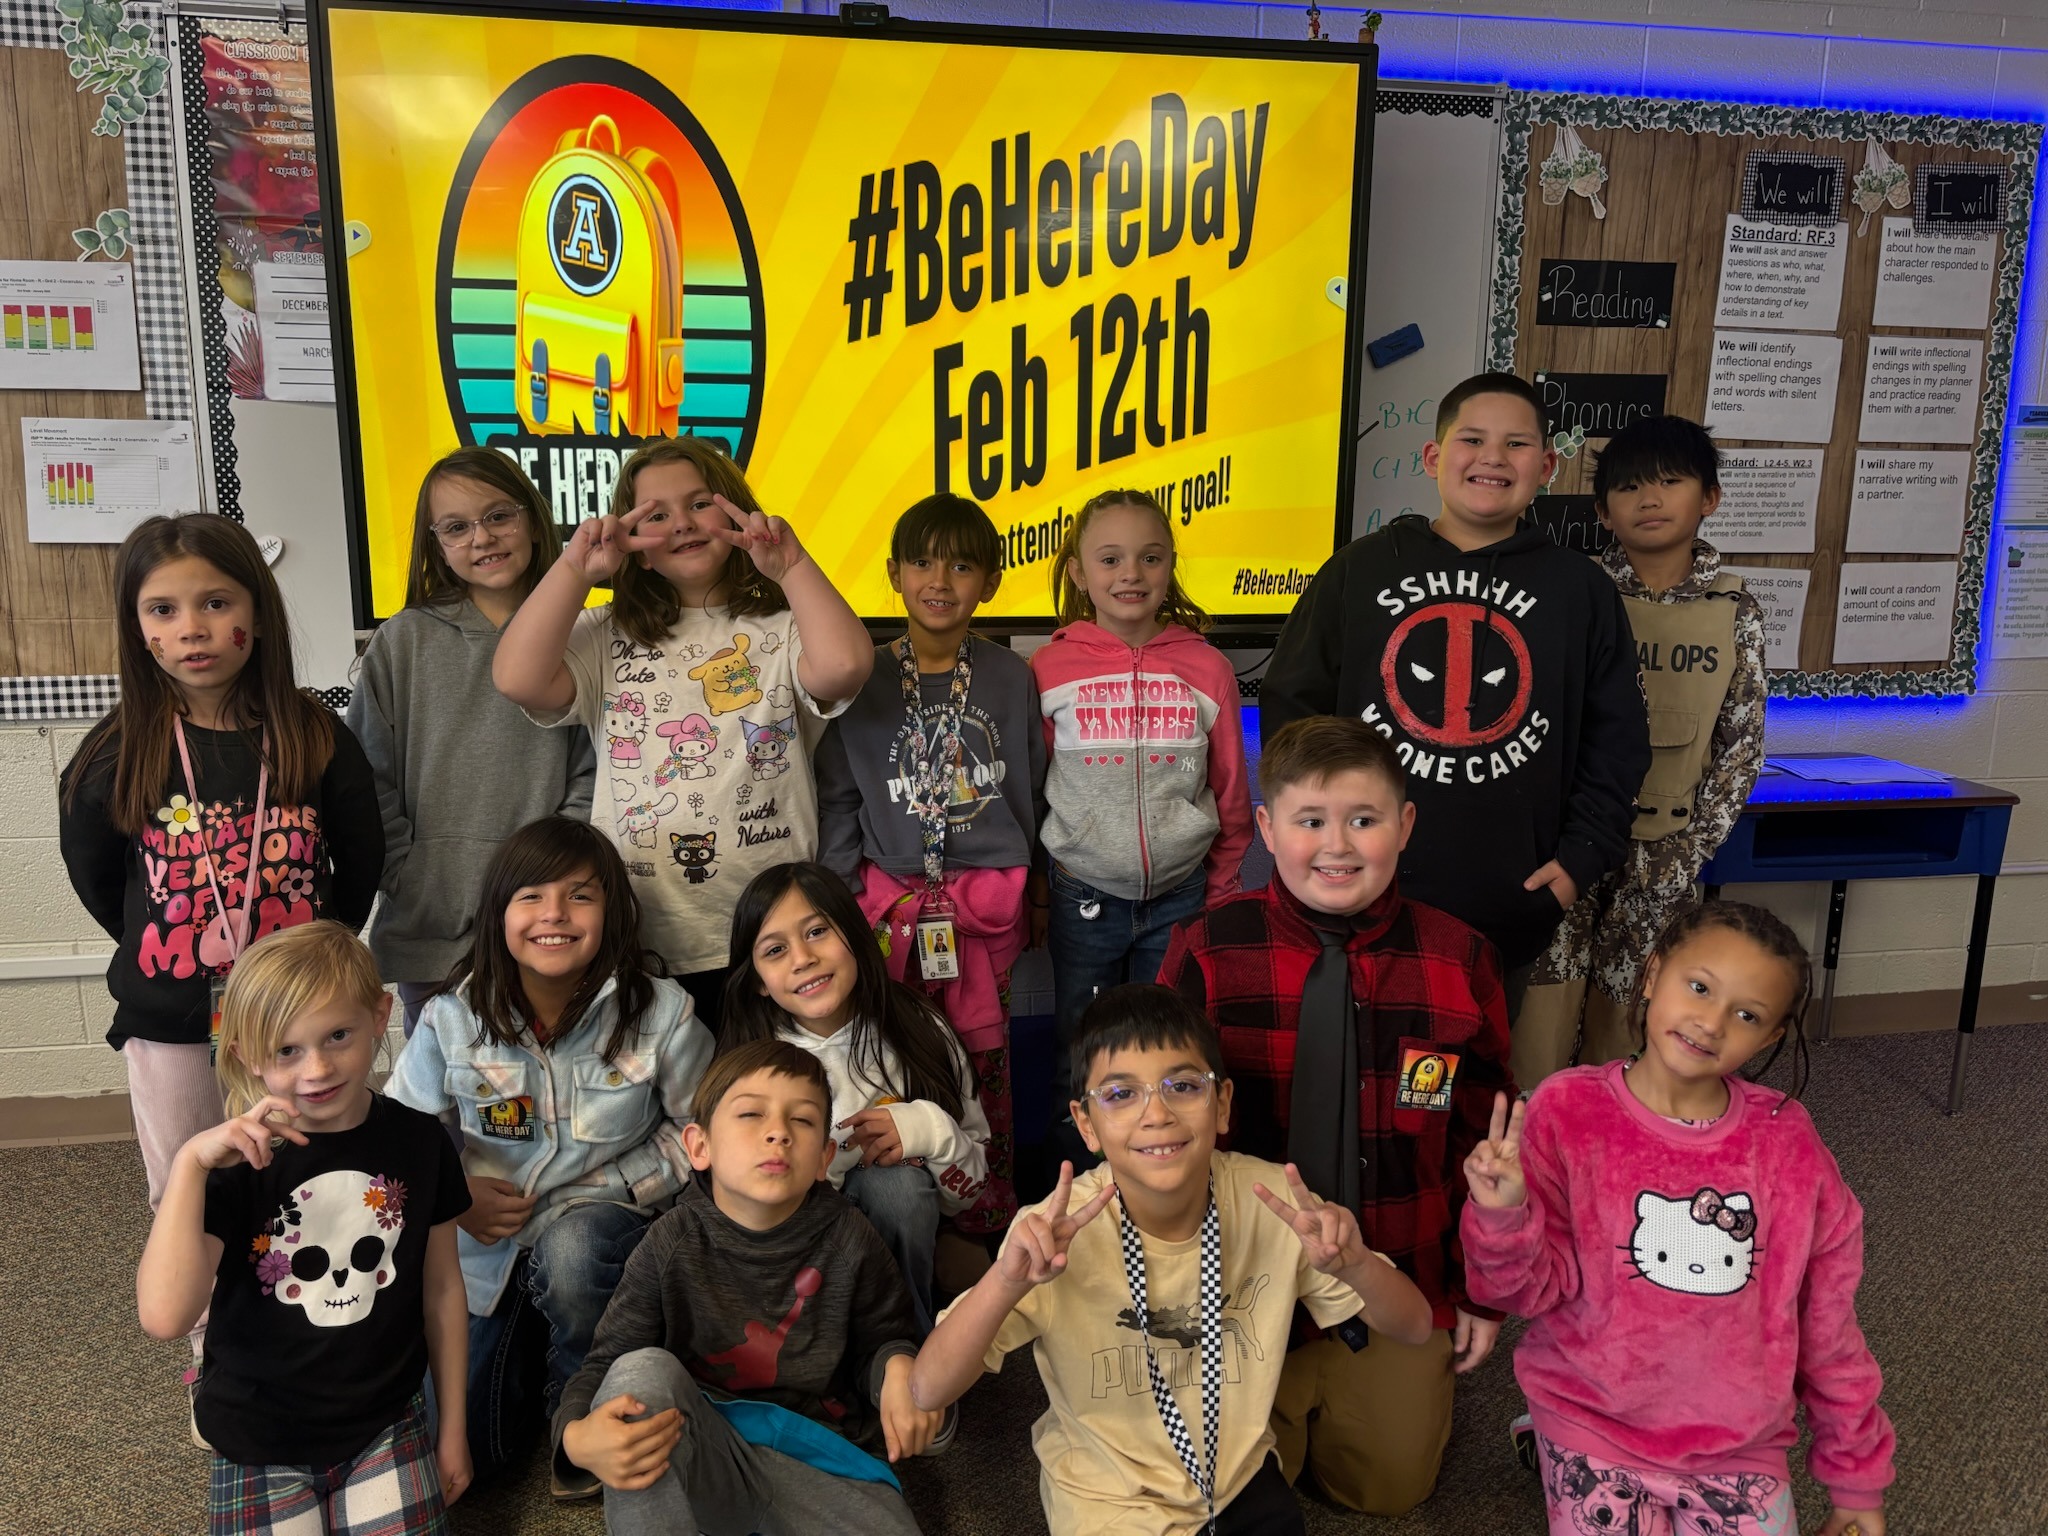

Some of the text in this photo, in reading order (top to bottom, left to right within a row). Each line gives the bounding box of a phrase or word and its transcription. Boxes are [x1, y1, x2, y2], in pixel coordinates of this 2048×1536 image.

[224, 41, 299, 60] CLASSROOM
[270, 120, 297, 131] respect
[301, 167, 314, 176] the
[1759, 172, 1829, 205] We will
[1931, 181, 1994, 216] I will
[842, 92, 1270, 345] #BeHereDay
[1732, 225, 1835, 245] Standard: RF.3
[1887, 228, 1891, 237] I
[1894, 228, 1911, 238] will
[1730, 244, 1827, 258] We will ask and answer
[1886, 243, 1976, 255] about how the main
[273, 252, 325, 264] SEPTEMBER
[1728, 258, 1768, 267] questions
[1783, 260, 1801, 270] who,
[1804, 262, 1825, 272] what,
[1884, 257, 1988, 271] character responded to
[1726, 270, 1820, 284] where, when, why, and
[1883, 272, 1935, 285] challenges.
[1724, 282, 1806, 295] how to demonstrate
[1548, 265, 1654, 329] Reading
[1723, 295, 1808, 310] understanding of key
[282, 300, 328, 311] DECEMBER
[1721, 307, 1784, 319] details in a text.
[303, 347, 332, 358] MARCH
[1719, 340, 1796, 356] We will identify
[1873, 346, 1971, 358] I will write inflectional
[1717, 355, 1812, 372] inflectional endings
[1872, 361, 1966, 374] endings with spelling
[1715, 370, 1822, 386] with spelling changes
[1871, 375, 1973, 388] changes in my planner
[933, 275, 1211, 501] Feb 12th
[1713, 386, 1817, 400] and words with silent
[1869, 390, 1961, 402] and practice reading
[1711, 400, 1745, 412] letters.
[1868, 404, 1957, 416] them with a partner.
[1860, 459, 1934, 471] I will share my
[549, 447, 638, 526] HER
[1859, 474, 1958, 487] narrative writing with
[1181, 455, 1232, 526] goal!
[1857, 490, 1905, 501] a partner.
[1777, 578, 1803, 588] coins
[1844, 586, 1848, 595] I
[1850, 586, 1867, 596] will
[1869, 586, 1895, 595] count
[1905, 584, 1941, 594] random
[1377, 570, 1538, 618] SSHHHH
[1843, 597, 1935, 609] amount of coins and
[1775, 608, 1793, 617] and
[1842, 612, 1935, 623] determine the value.
[1670, 643, 1719, 674] OPS
[615, 662, 656, 683] Cute
[1077, 680, 1194, 703] NEW YORK
[1075, 705, 1197, 741] YANKEES
[889, 703, 1001, 763] THE SIDE THE MOON
[1395, 741, 1457, 785] ONE
[1465, 709, 1550, 784] CARES
[739, 797, 778, 823] with
[142, 805, 318, 858] MINIATURE
[951, 822, 972, 834] 1973
[737, 825, 792, 848] Nature
[165, 887, 214, 925] OF
[1400, 1090, 1446, 1106] BE HERE DAY
[485, 1123, 531, 1136] BE HERE DAY
